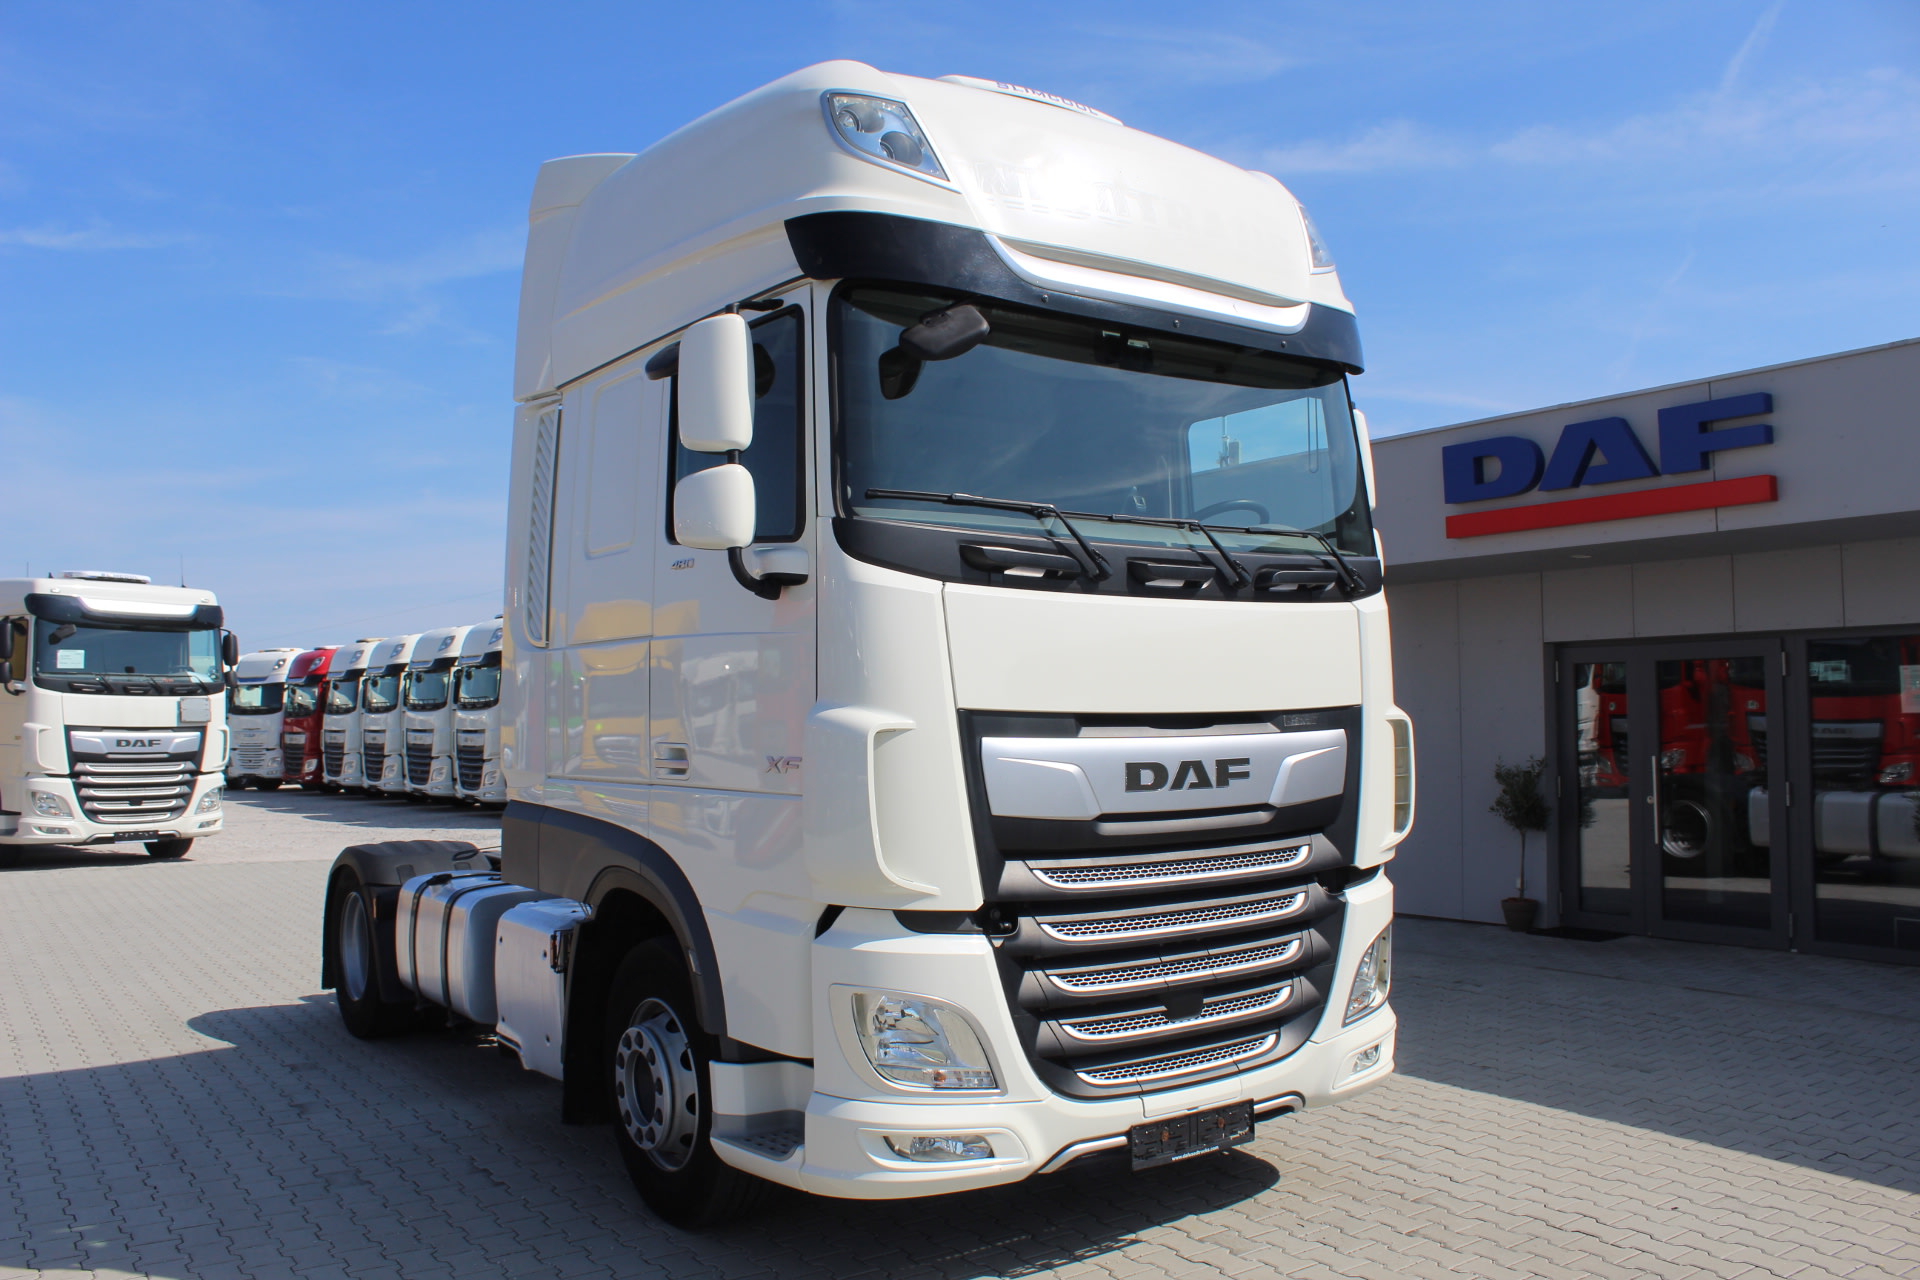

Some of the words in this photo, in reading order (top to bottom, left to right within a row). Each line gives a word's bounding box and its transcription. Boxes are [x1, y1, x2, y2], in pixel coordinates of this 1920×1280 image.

[1442, 392, 1774, 504] DAF
[116, 739, 161, 748] DAF
[765, 755, 803, 774] XF
[1125, 757, 1250, 793] DAF
